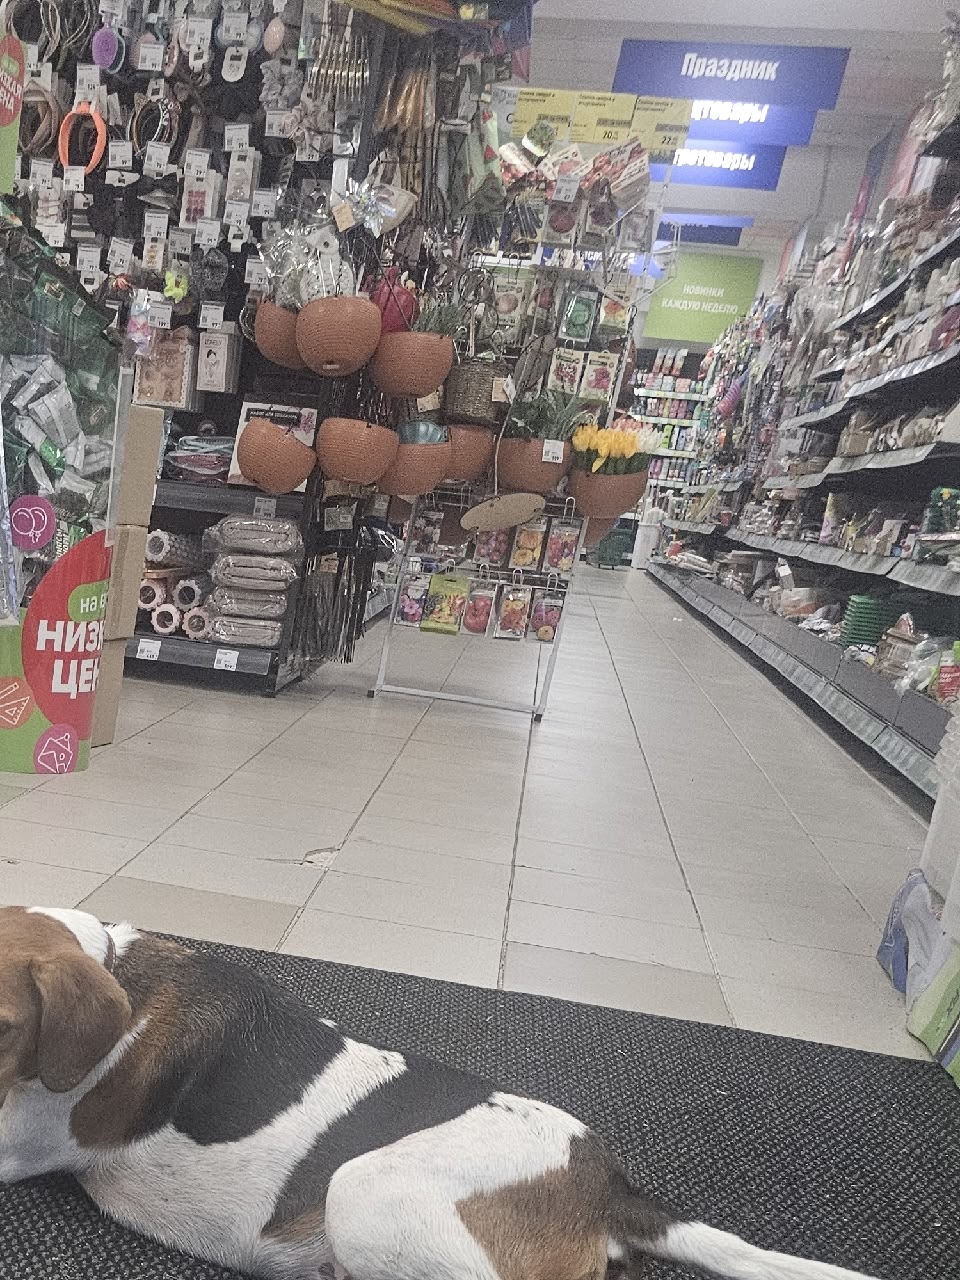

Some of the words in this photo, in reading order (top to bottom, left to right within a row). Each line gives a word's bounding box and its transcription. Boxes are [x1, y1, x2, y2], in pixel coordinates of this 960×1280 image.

[681, 53, 780, 81] Праздник
[683, 284, 725, 298] НОВИНКИ
[661, 298, 701, 312] КАЖДУЮ
